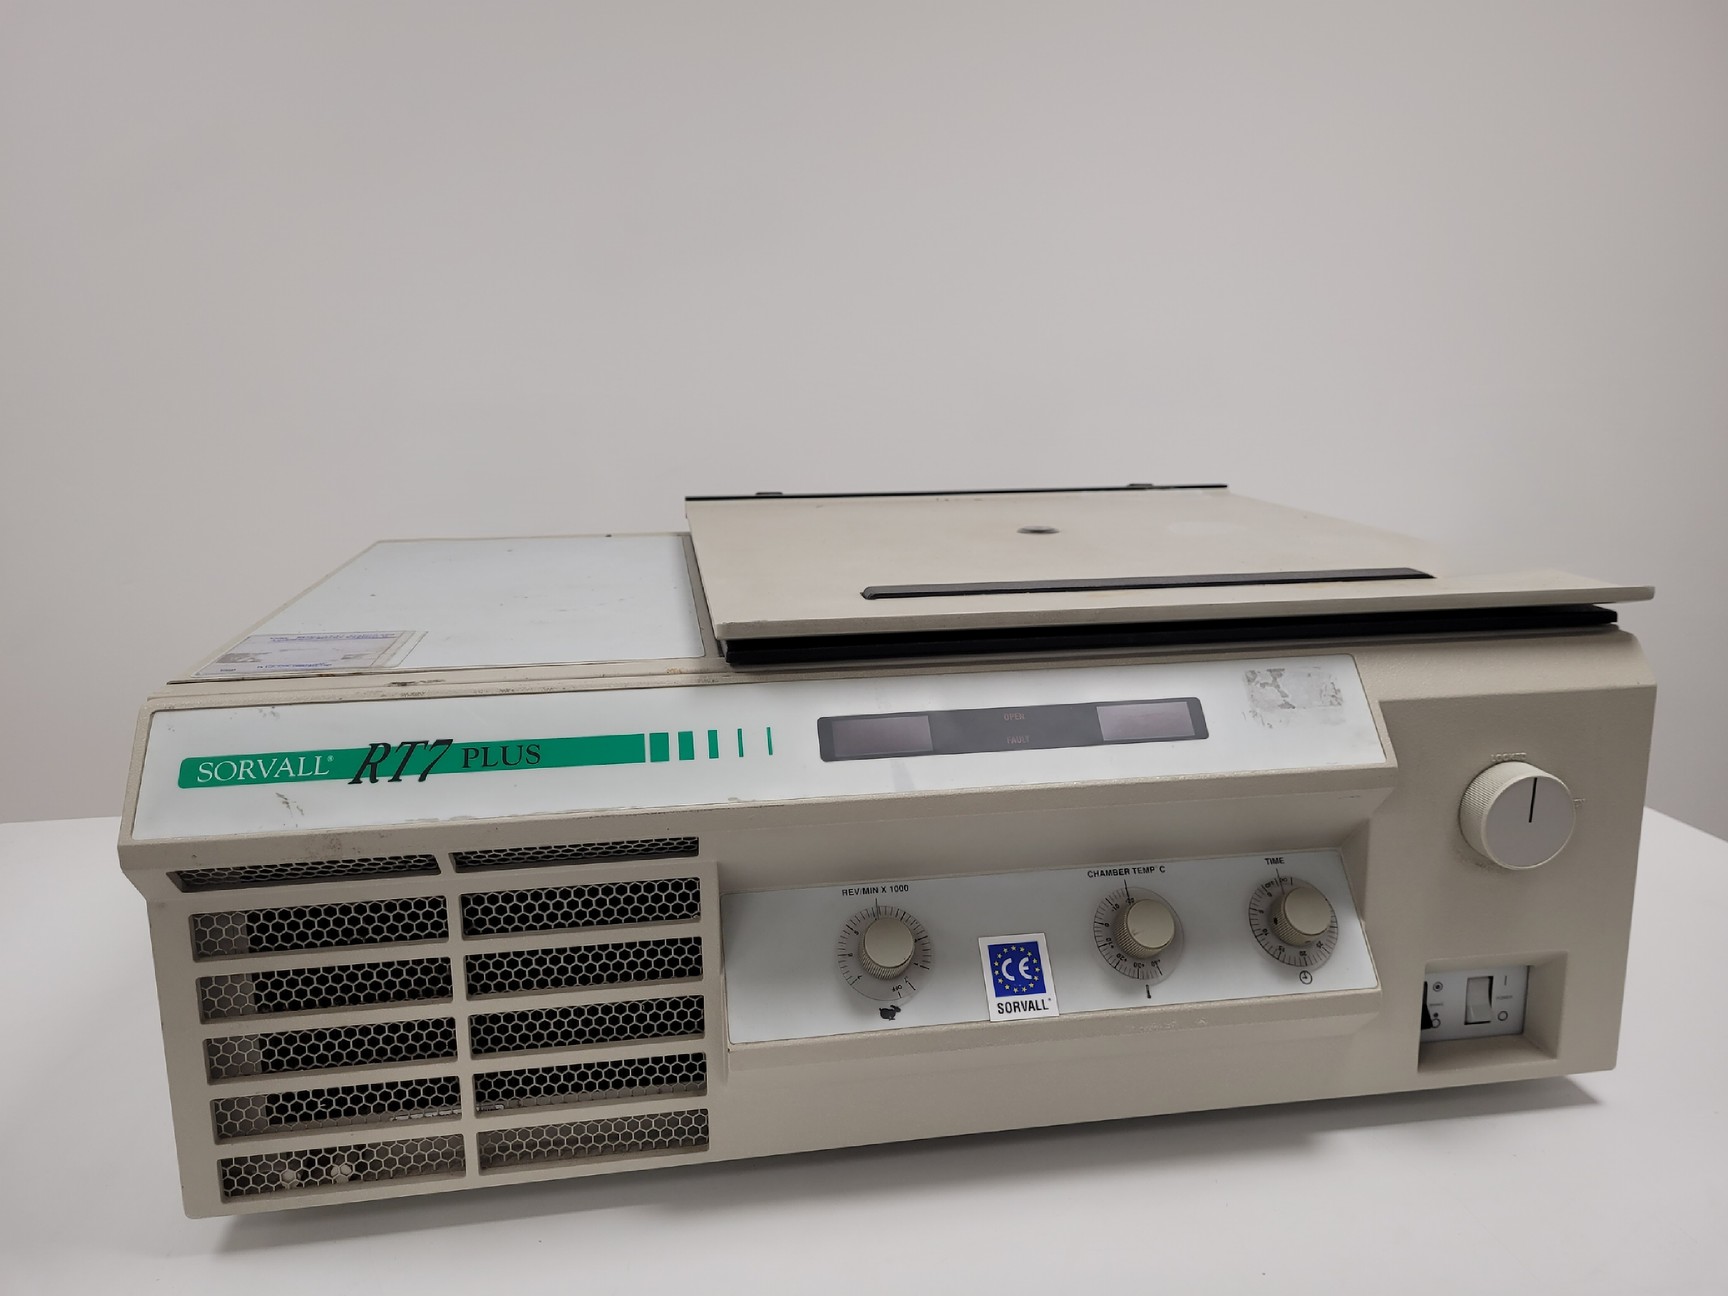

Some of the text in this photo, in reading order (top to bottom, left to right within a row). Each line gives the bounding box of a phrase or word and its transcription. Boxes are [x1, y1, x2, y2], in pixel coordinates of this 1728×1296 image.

[1003, 712, 1025, 721] OPEN
[1006, 735, 1030, 744] FAULT
[348, 738, 454, 786] RT7
[461, 743, 542, 768] PLUS
[1264, 856, 1285, 866] TIME
[1087, 867, 1131, 879] CHAMBER
[1132, 866, 1156, 875] TEMP
[841, 887, 879, 896] REV/MIN
[889, 884, 909, 893] 1000
